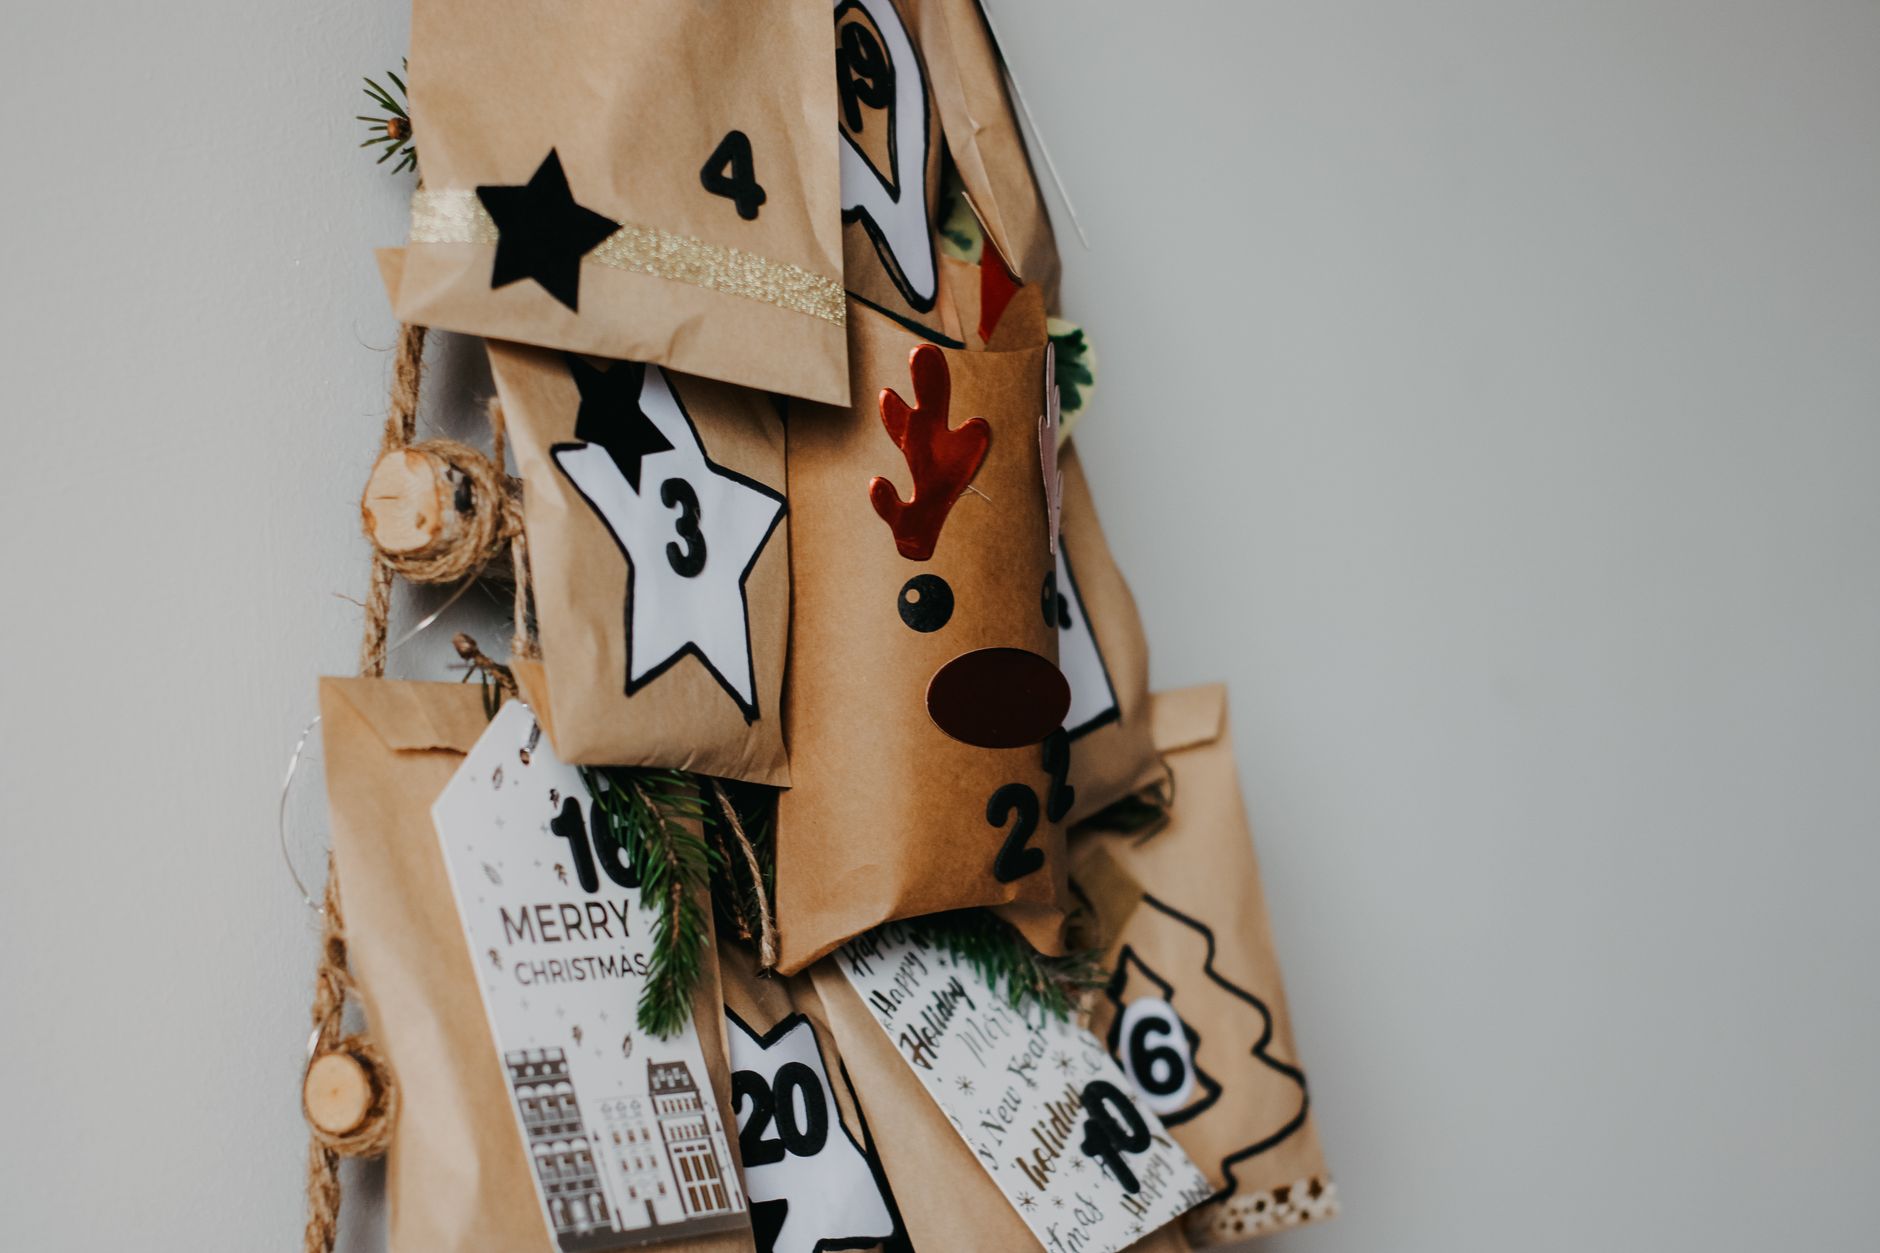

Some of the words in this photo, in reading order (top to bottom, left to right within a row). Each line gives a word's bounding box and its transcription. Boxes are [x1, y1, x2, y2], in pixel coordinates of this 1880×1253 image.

[700, 130, 767, 221] 4
[660, 477, 708, 578] 3
[500, 899, 631, 945] MERRY
[514, 953, 650, 986] CHRISTMAS
[868, 951, 928, 1019] Happy
[900, 975, 976, 1071] Holiday
[956, 997, 1013, 1068] Merr
[1129, 1016, 1187, 1096] 6
[731, 1061, 828, 1168] 20
[980, 1086, 1022, 1148] New
[1006, 1026, 1049, 1090] Year
[1080, 1079, 1151, 1194] 10
[1119, 1152, 1174, 1221] Happy
